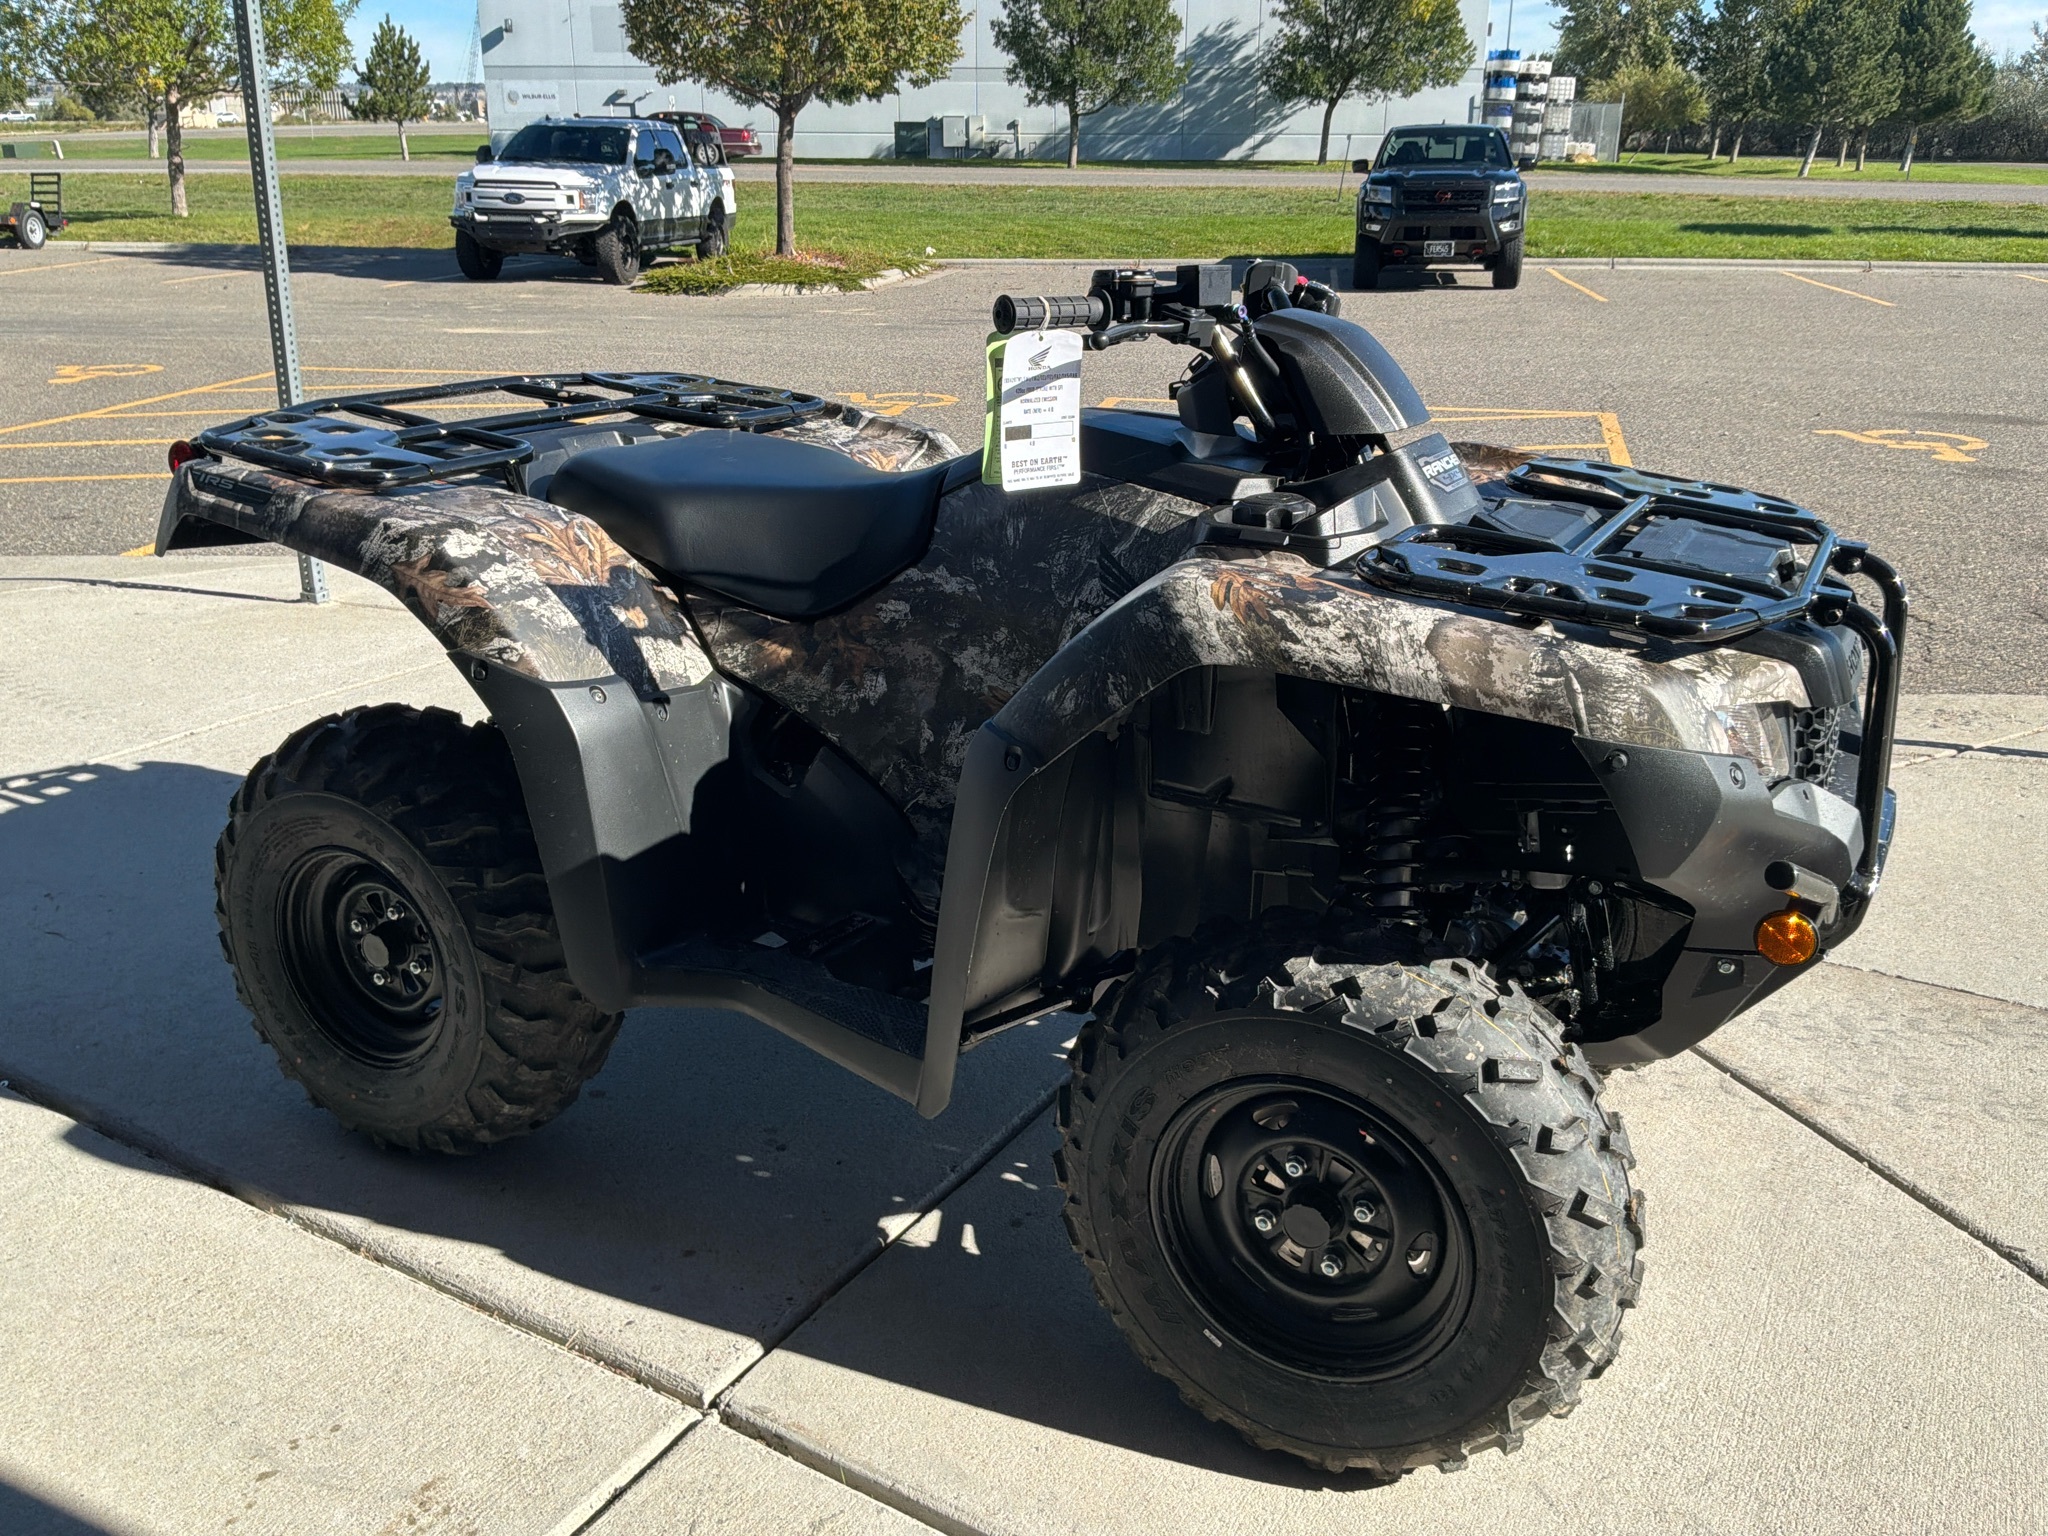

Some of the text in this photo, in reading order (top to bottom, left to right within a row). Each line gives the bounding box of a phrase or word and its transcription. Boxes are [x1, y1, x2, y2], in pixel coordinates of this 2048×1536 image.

[1011, 459, 1028, 468] BEST
[1029, 458, 1039, 466] ON
[1013, 466, 1046, 475] PERFORMANCE
[1421, 453, 1461, 479] RANCHE
[199, 472, 235, 490] IRS
[1108, 1086, 1186, 1326] MAXXIS
